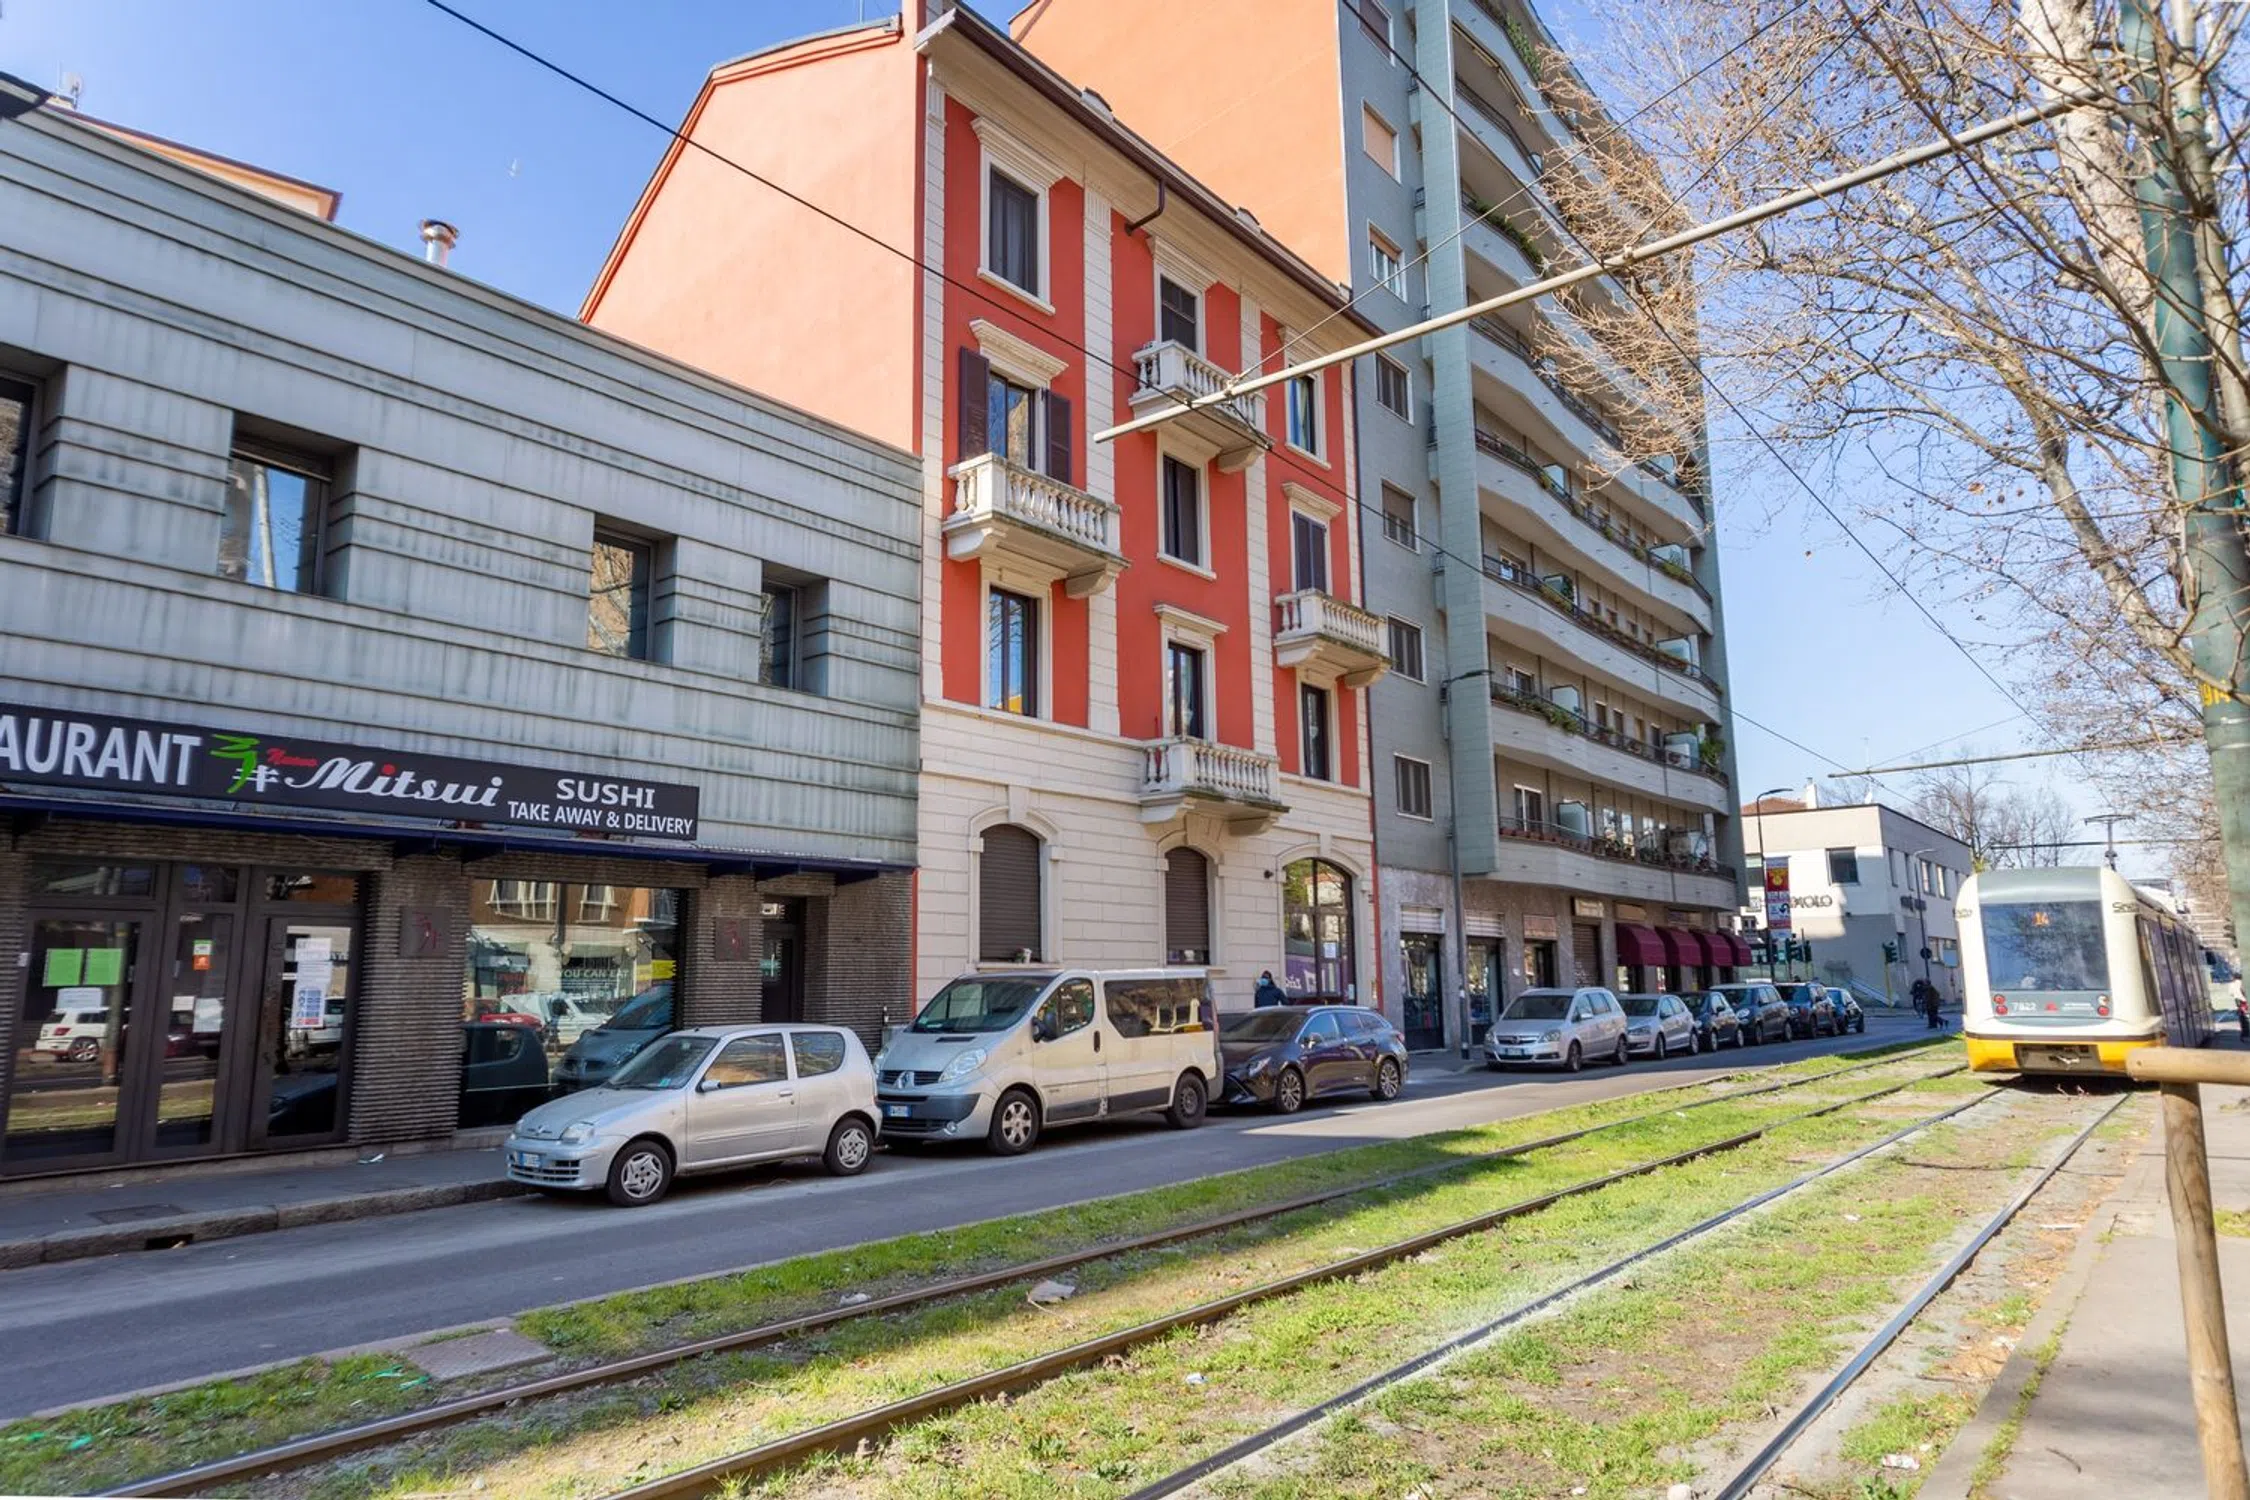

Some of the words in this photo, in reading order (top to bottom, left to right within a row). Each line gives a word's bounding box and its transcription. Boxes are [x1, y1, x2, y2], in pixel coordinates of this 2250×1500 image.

[0, 714, 202, 785] AURANT
[285, 757, 503, 806] Mitsui
[556, 778, 656, 810] SUSHI
[508, 801, 550, 822] TAKE
[554, 806, 602, 826] AWAY
[606, 811, 620, 829] &
[624, 813, 693, 836] DELIVERY
[583, 968, 606, 979] CAN
